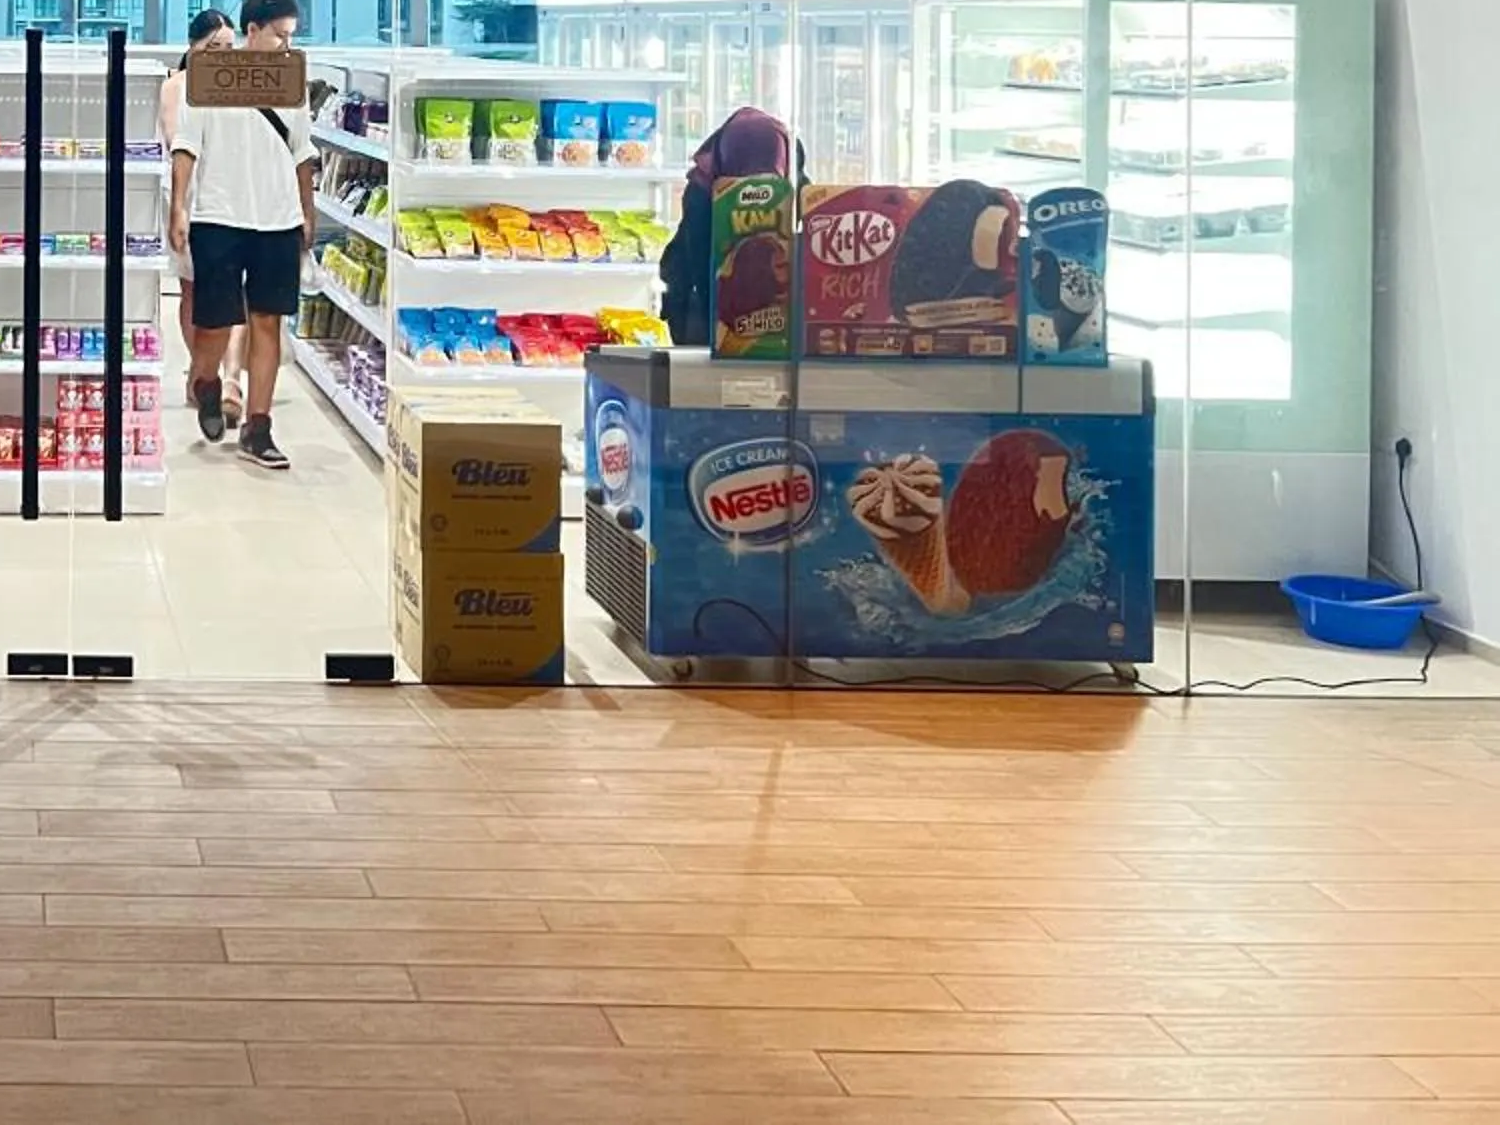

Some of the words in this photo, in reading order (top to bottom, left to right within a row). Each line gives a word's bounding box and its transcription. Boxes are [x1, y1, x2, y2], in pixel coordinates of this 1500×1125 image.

[214, 68, 281, 88] OPEN
[741, 189, 770, 202] MILO
[1033, 199, 1107, 222] OREO
[820, 214, 891, 264] KitKat
[452, 458, 537, 487] Bleu
[711, 456, 734, 474] ICE
[454, 588, 539, 617] Bleu
